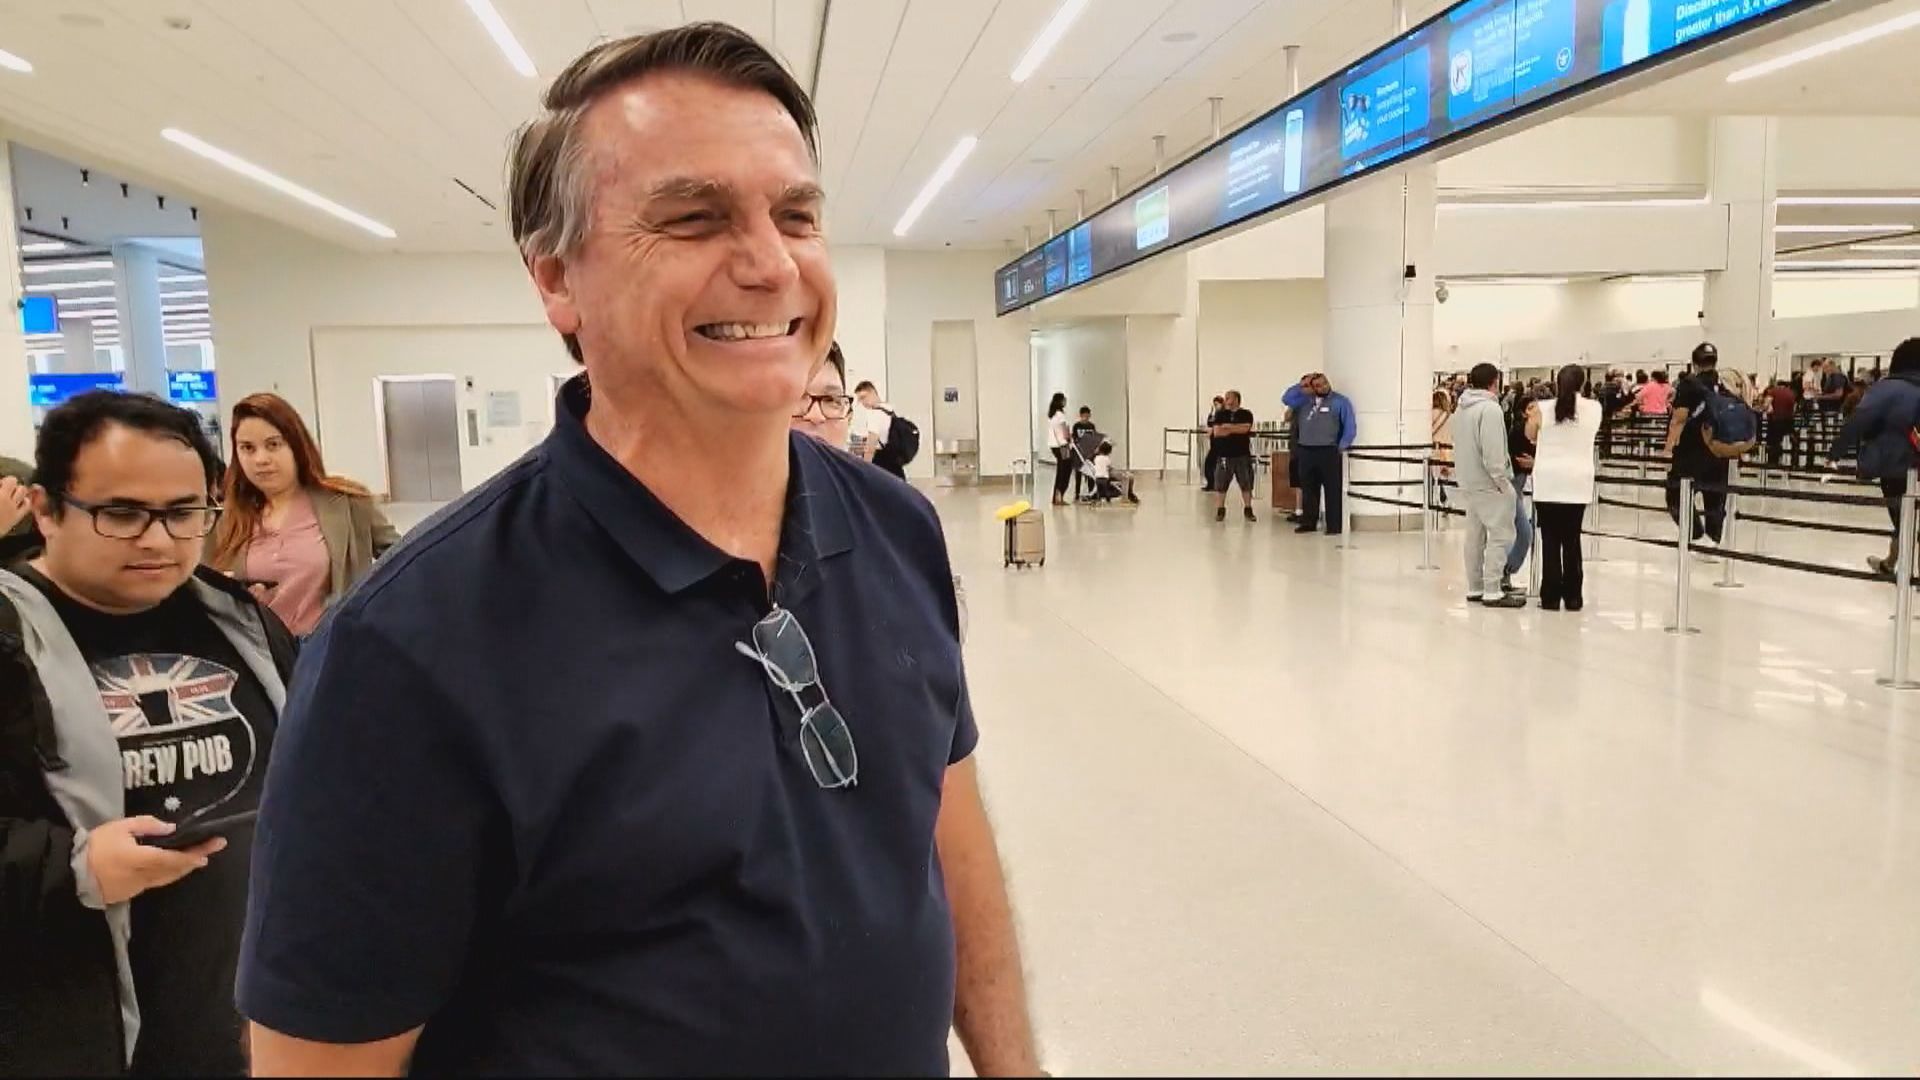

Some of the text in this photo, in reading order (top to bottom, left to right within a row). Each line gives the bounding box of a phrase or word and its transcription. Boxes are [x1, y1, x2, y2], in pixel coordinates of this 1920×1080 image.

[1675, 16, 1713, 44] greater
[1714, 4, 1740, 26] than
[123, 735, 233, 790] REW PUB
